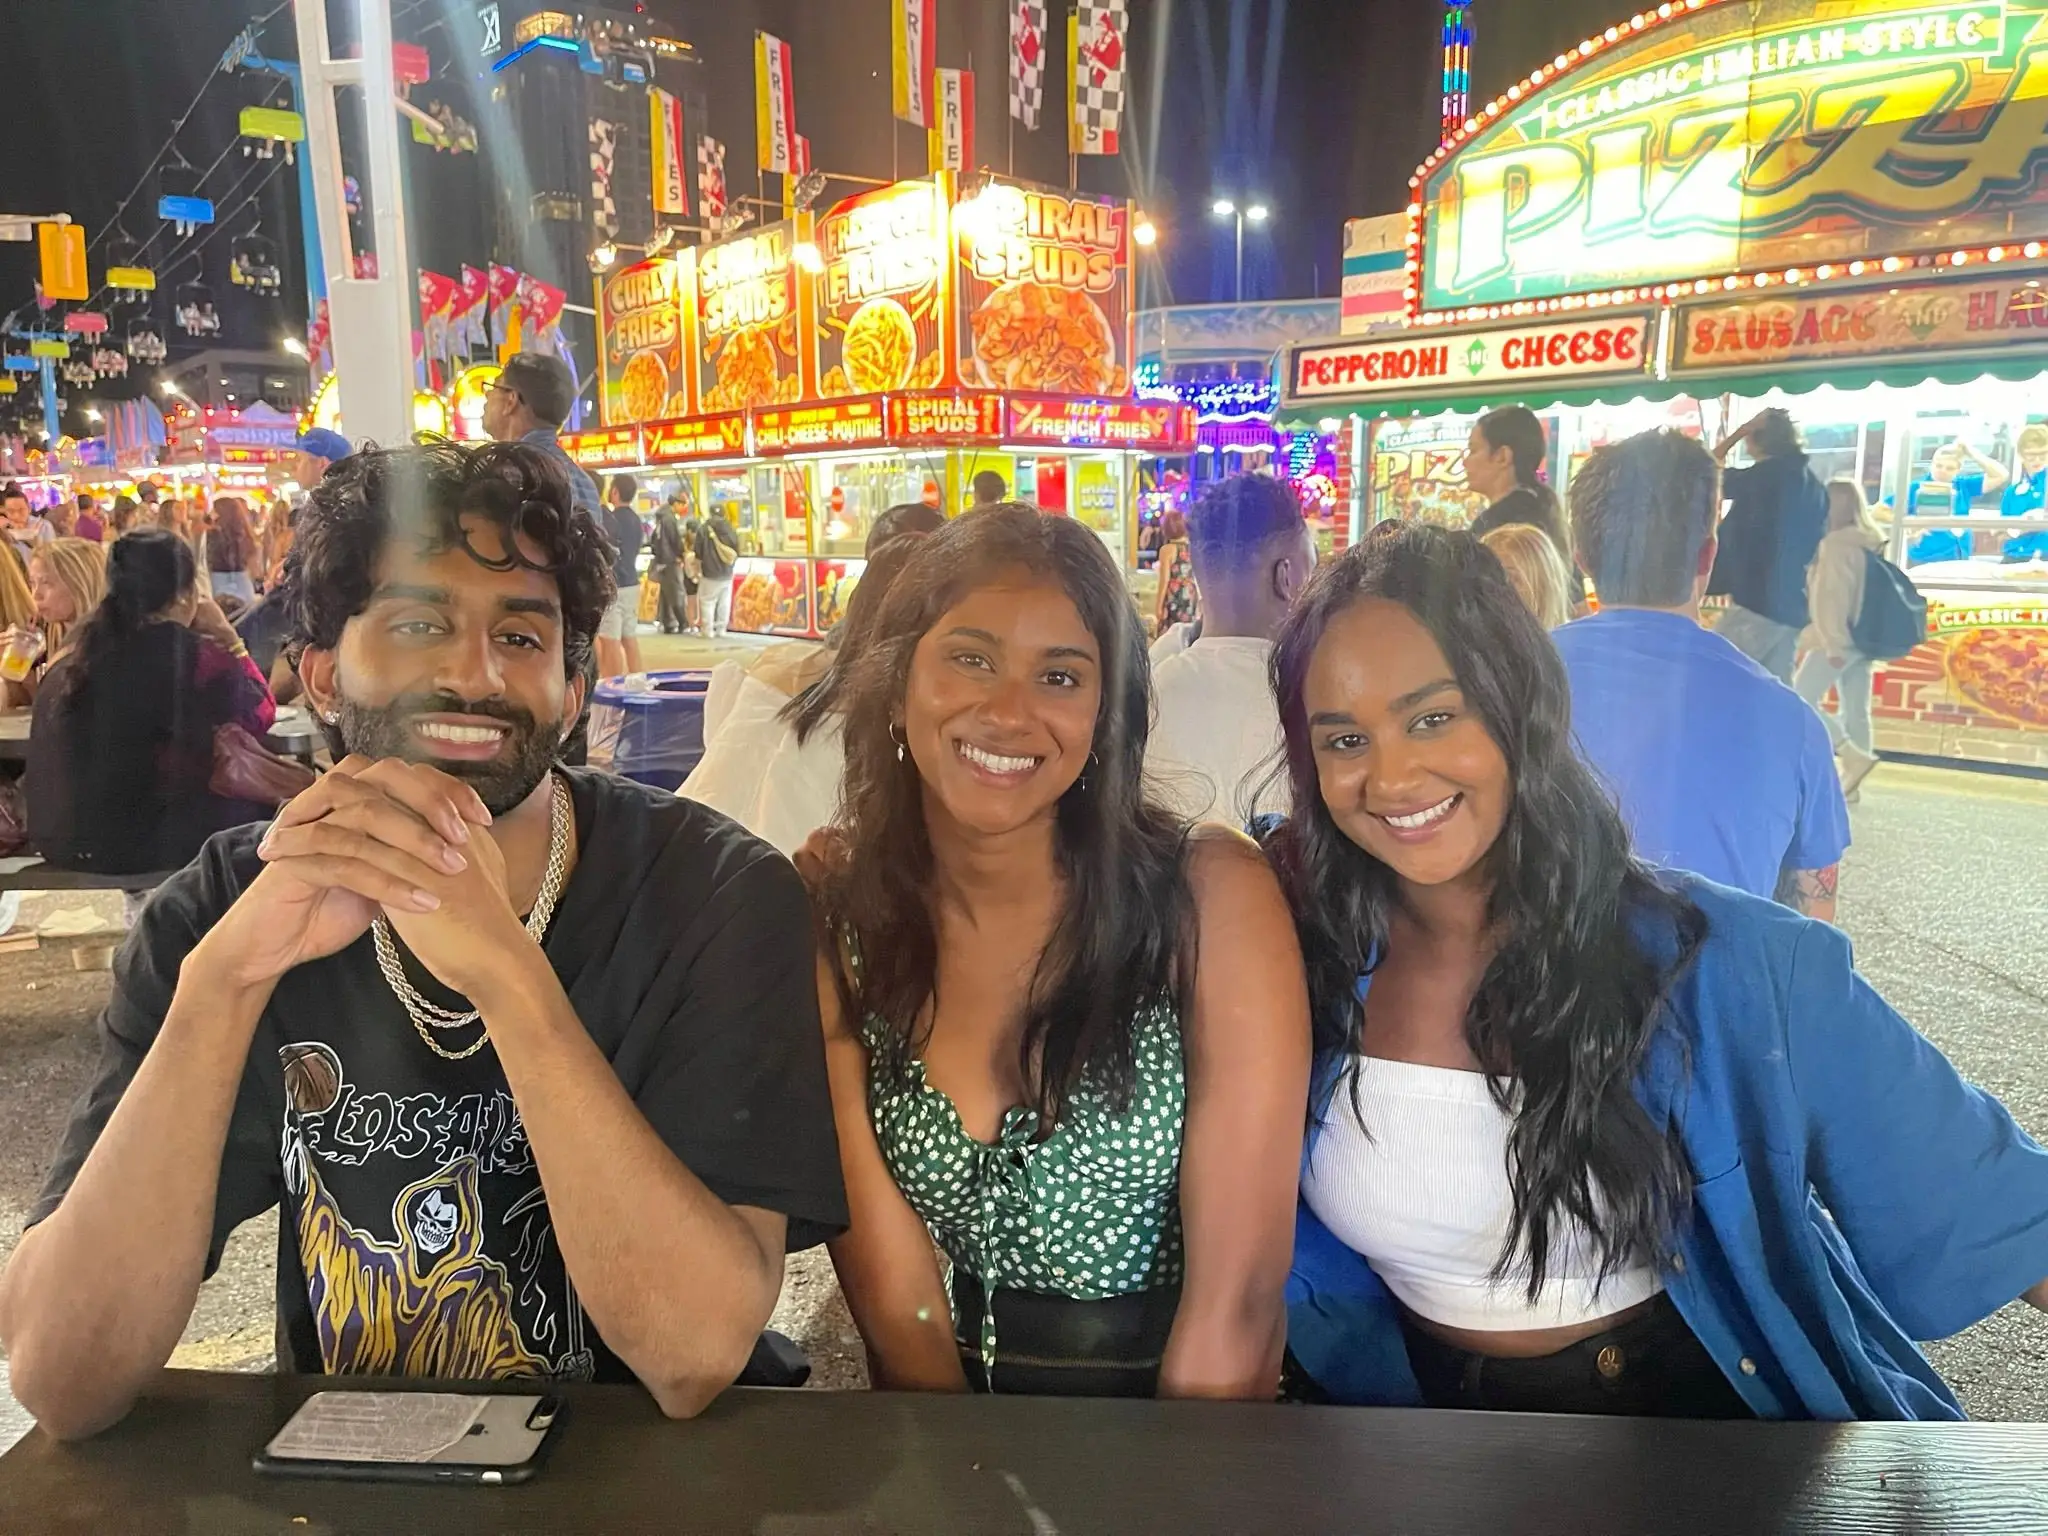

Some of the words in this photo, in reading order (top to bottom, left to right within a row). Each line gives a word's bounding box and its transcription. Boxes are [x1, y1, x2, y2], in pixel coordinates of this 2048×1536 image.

[907, 0, 921, 112] RIES
[1556, 61, 1691, 129] CLASSIC
[1700, 33, 1845, 86] ITALIAN
[1860, 12, 1985, 56] STYLE
[769, 50, 787, 160] FRIES
[946, 80, 959, 171] FRIE
[976, 183, 1118, 249] PIRAL
[610, 264, 675, 312] CURLY
[975, 244, 1114, 290] SPUDS
[615, 310, 677, 351] FRIES
[706, 278, 786, 333] SPUDS
[1692, 301, 1878, 355] SAUSAGE
[1300, 345, 1449, 387] PEPPERONI
[1501, 325, 1639, 370] CHEESE
[905, 400, 980, 417] SPIRAL
[907, 416, 979, 434] SPUDS
[1032, 418, 1099, 438] FRENCH
[1105, 420, 1151, 440] FRIES
[1374, 448, 1471, 492] PIZ
[1940, 608, 2024, 627] CLASSIC
[300, 1083, 447, 1167] LOS
